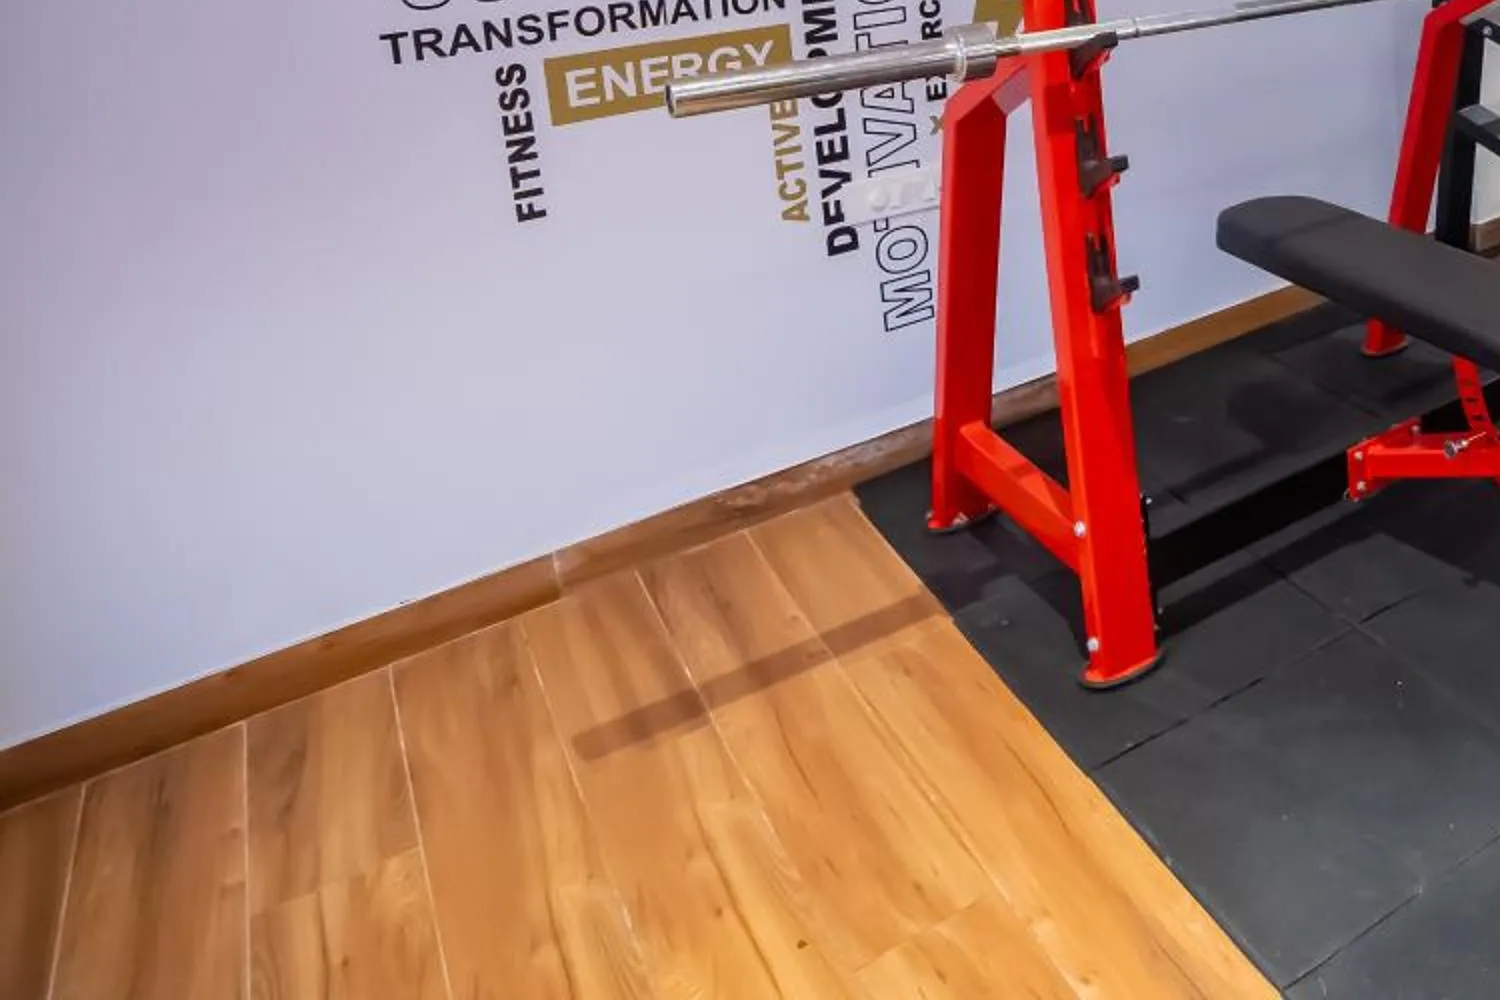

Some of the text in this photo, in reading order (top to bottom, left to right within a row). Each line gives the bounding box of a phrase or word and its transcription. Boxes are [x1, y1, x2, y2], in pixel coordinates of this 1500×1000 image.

[565, 39, 774, 107] ENERGY
[496, 62, 547, 223] FITNESS
[770, 98, 810, 222] ACTIVE
